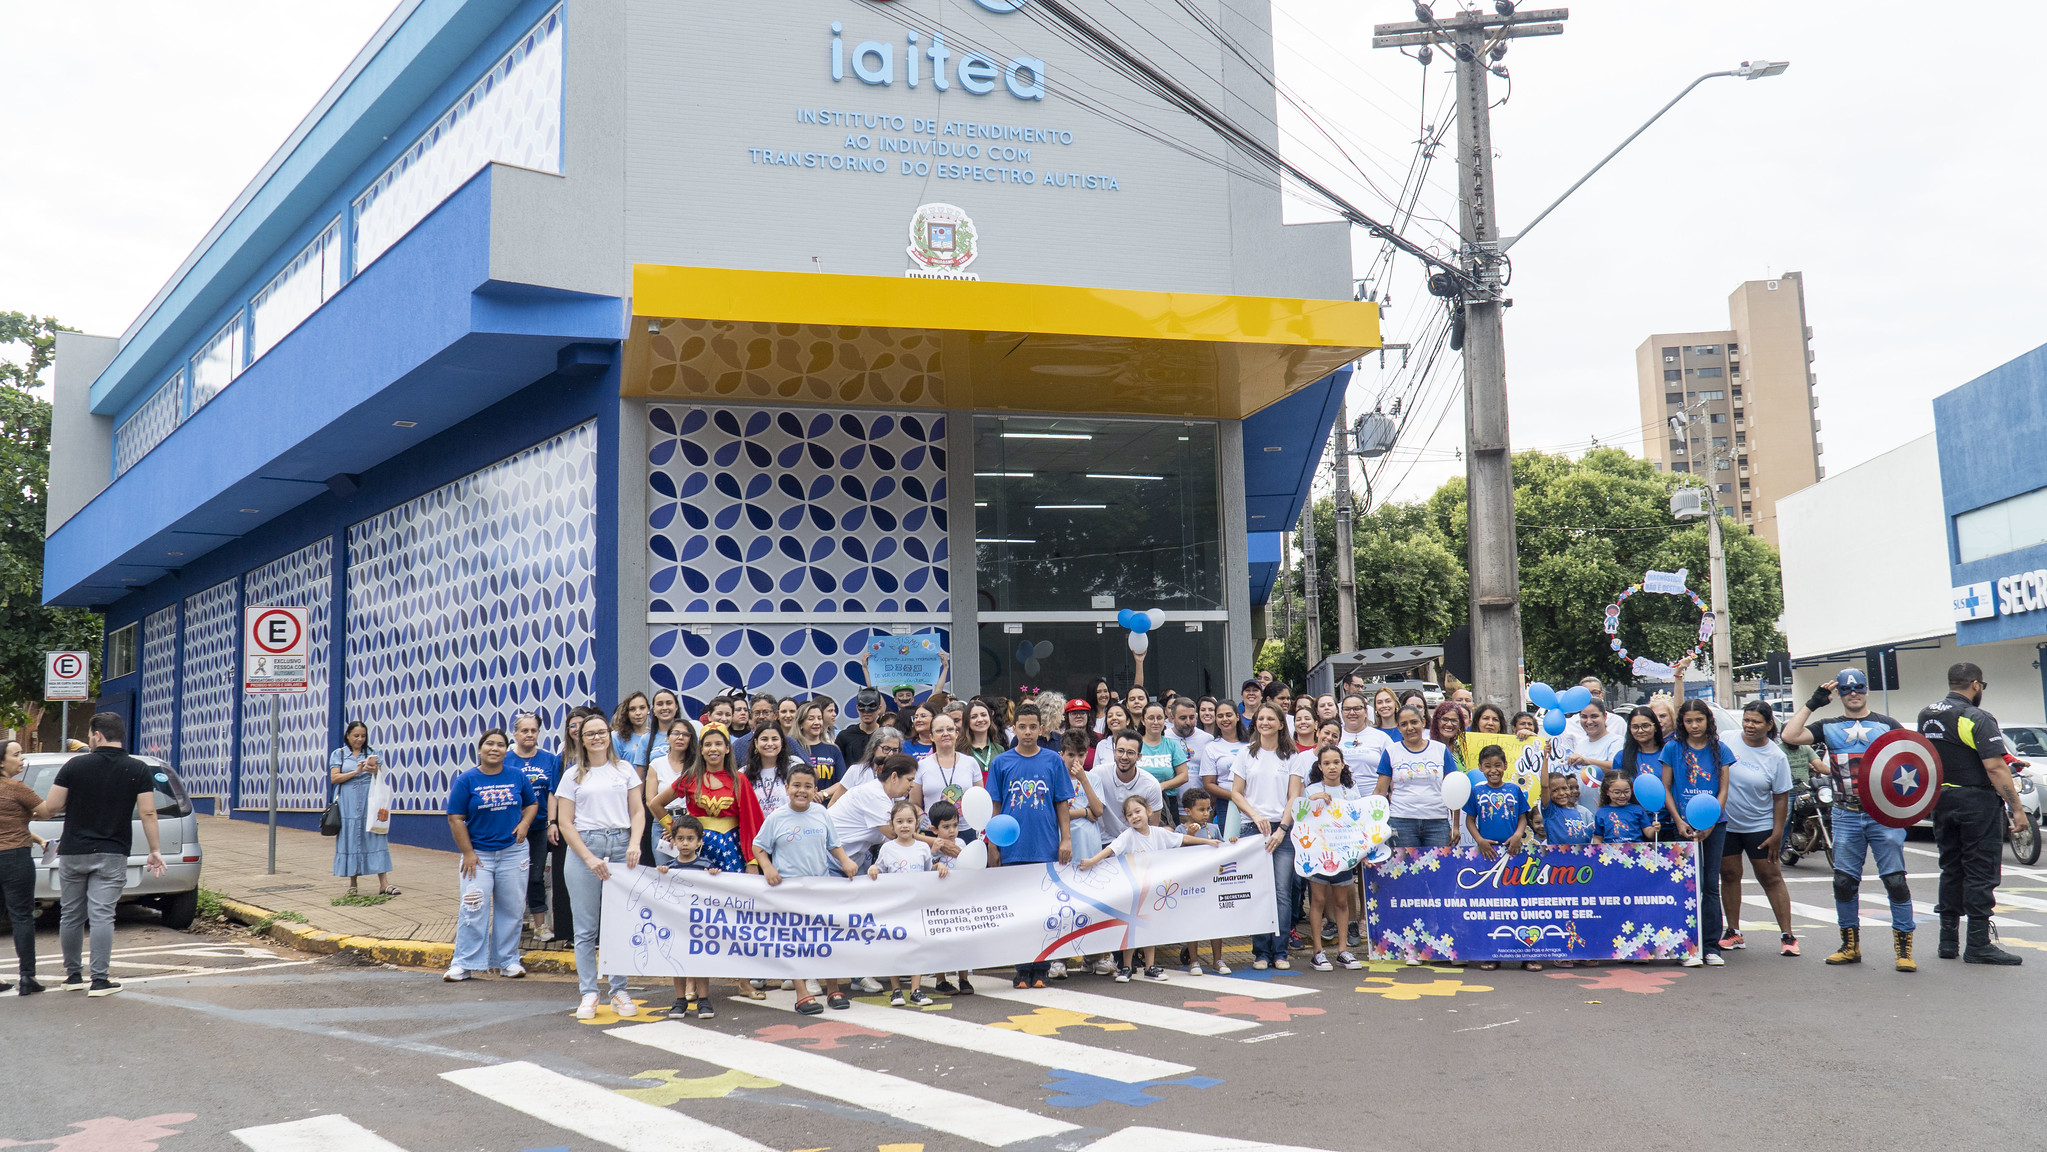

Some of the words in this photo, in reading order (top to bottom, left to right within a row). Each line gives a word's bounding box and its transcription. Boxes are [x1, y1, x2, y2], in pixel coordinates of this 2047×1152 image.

[832, 20, 1045, 100] iaitea
[797, 108, 906, 132] INSTITUTO
[913, 118, 937, 134] DE
[943, 121, 1074, 146] ATENDIMENTO
[844, 134, 871, 150] AO
[879, 136, 981, 160] INDIVÍDUO
[988, 146, 1031, 163] COM
[748, 148, 888, 173] TRANSTORNO
[901, 160, 929, 178] DO
[938, 163, 1036, 184] ESPECTRO
[1044, 171, 1120, 192] AUTISTA
[269, 620, 286, 642] E
[61, 659, 73, 673] E
[1847, 674, 1857, 684] A
[1213, 874, 1253, 883] Umuarama
[1457, 853, 1593, 890] Autismo
[690, 895, 699, 906] 2
[703, 895, 721, 907] de
[724, 896, 755, 910] Abril
[1390, 896, 1398, 908] É
[1400, 898, 1441, 908] APENAS
[1444, 898, 1467, 908] UMA
[1469, 897, 1518, 908] MANEIRA
[1521, 896, 1579, 907] DIFERENTE
[1581, 896, 1597, 906] DE
[1599, 896, 1621, 906] VER
[1623, 896, 1632, 906] O
[1634, 895, 1677, 907] MUNDO,
[689, 908, 727, 924] DIA
[736, 910, 841, 927] MUNDIAL
[850, 912, 876, 927] DA
[926, 905, 983, 918] Informação
[986, 904, 1008, 914] gera
[928, 913, 972, 926] empatia,
[974, 910, 1015, 922] empatia
[1463, 910, 1486, 921] COM
[1488, 910, 1518, 921] JEITO
[1520, 908, 1553, 920] ÚNICO
[1555, 910, 1570, 920] DE
[1572, 909, 1601, 920] SER...
[689, 923, 907, 945] CONSCIENTIZAÇÃO
[929, 924, 953, 936] gera
[955, 920, 1000, 934] respeito.
[689, 939, 720, 955] DO
[728, 941, 832, 958] AUTISMO
